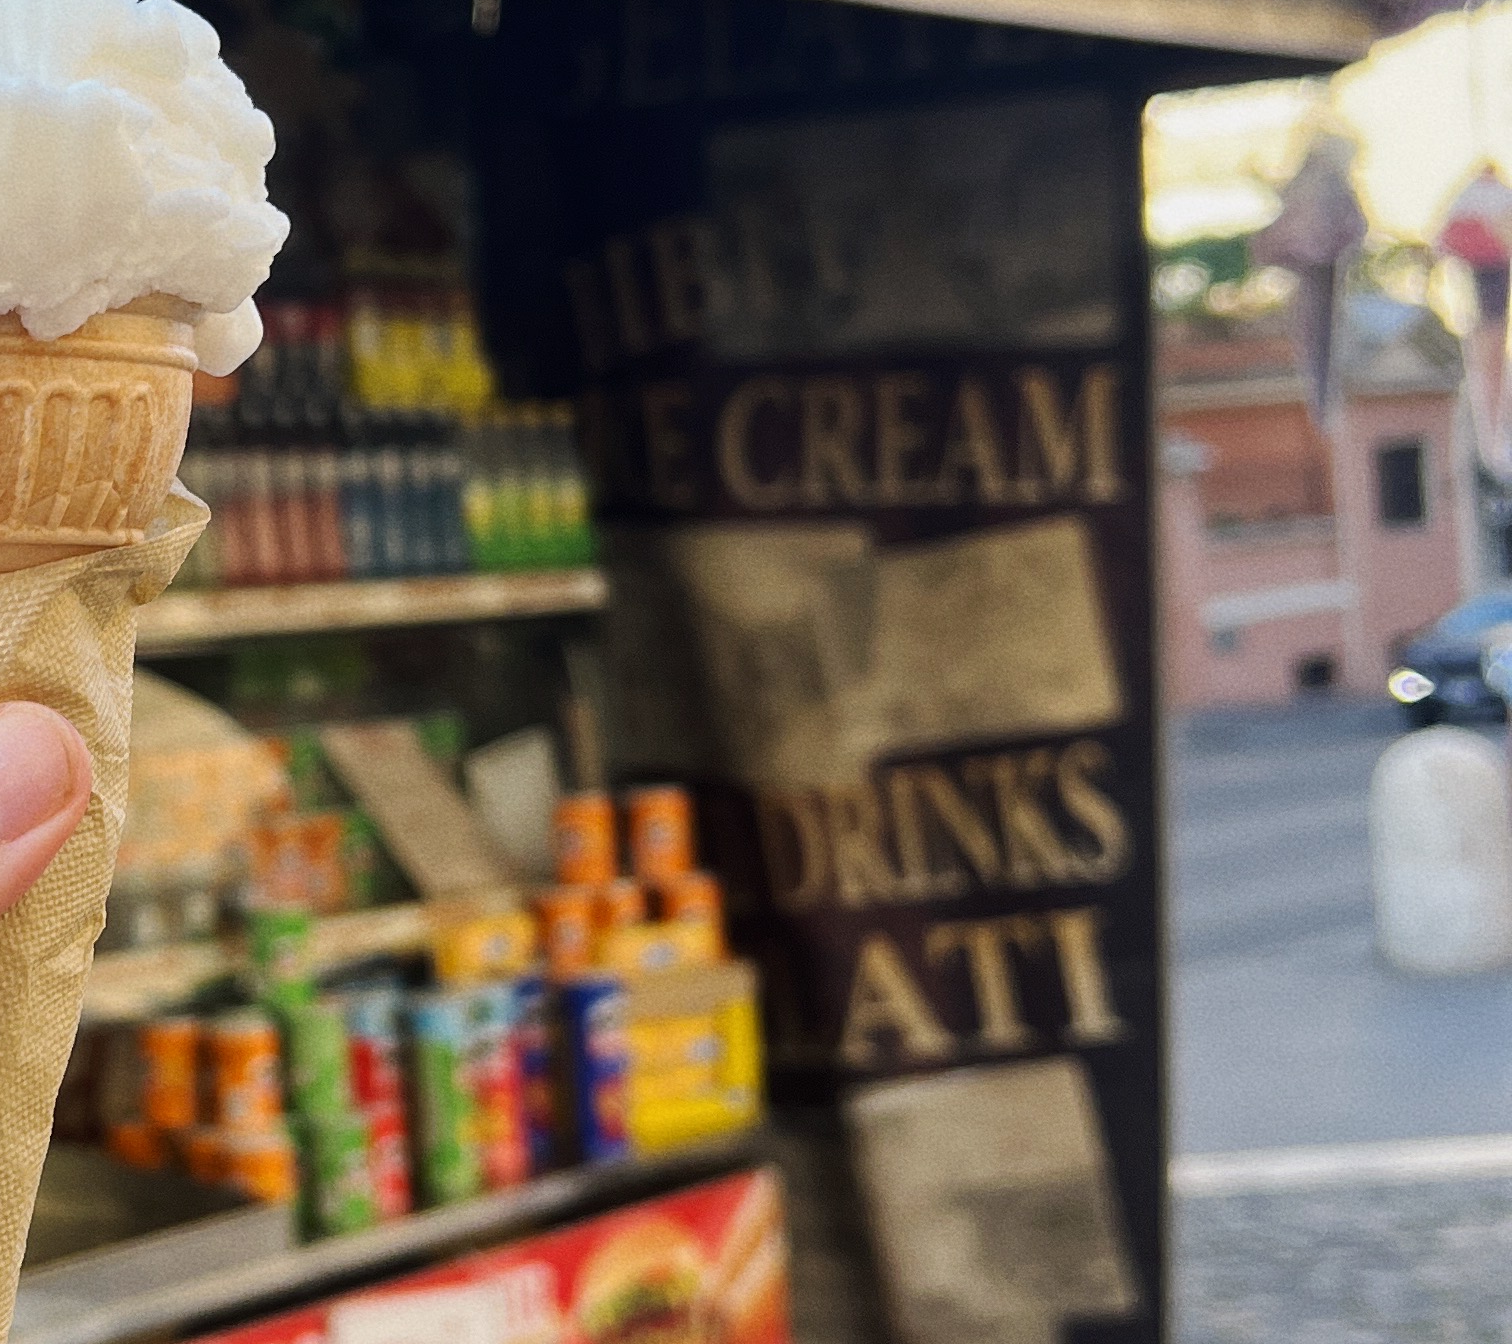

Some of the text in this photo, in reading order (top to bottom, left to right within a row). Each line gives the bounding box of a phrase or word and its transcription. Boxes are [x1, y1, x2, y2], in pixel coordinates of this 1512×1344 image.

[714, 364, 1124, 511] CREAM
[756, 739, 1131, 914] DRINKS
[833, 908, 1129, 1068] ATI
